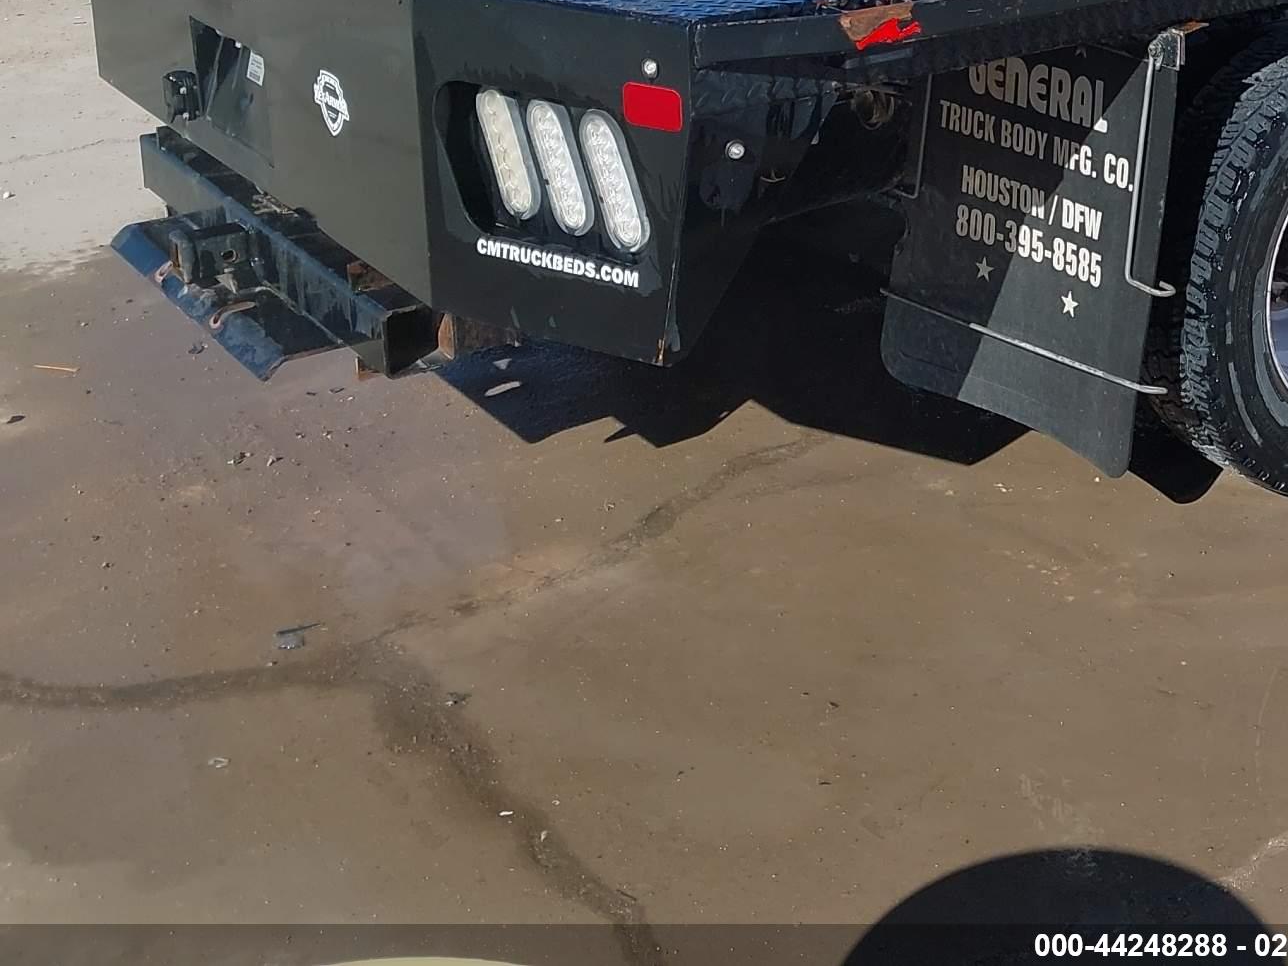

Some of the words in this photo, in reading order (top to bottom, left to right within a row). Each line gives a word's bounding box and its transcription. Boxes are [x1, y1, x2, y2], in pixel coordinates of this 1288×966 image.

[968, 57, 1109, 134] GENERAL
[939, 99, 996, 144] TRUCK
[1000, 116, 1048, 161] BODY
[1052, 135, 1097, 179] MFG.
[1103, 152, 1134, 192] CO.
[960, 164, 1046, 221] HOUSTON
[1061, 197, 1103, 242] DFW
[476, 237, 639, 288] CMTRUCKBEDS.COM
[954, 203, 1102, 289] 800-395-8585
